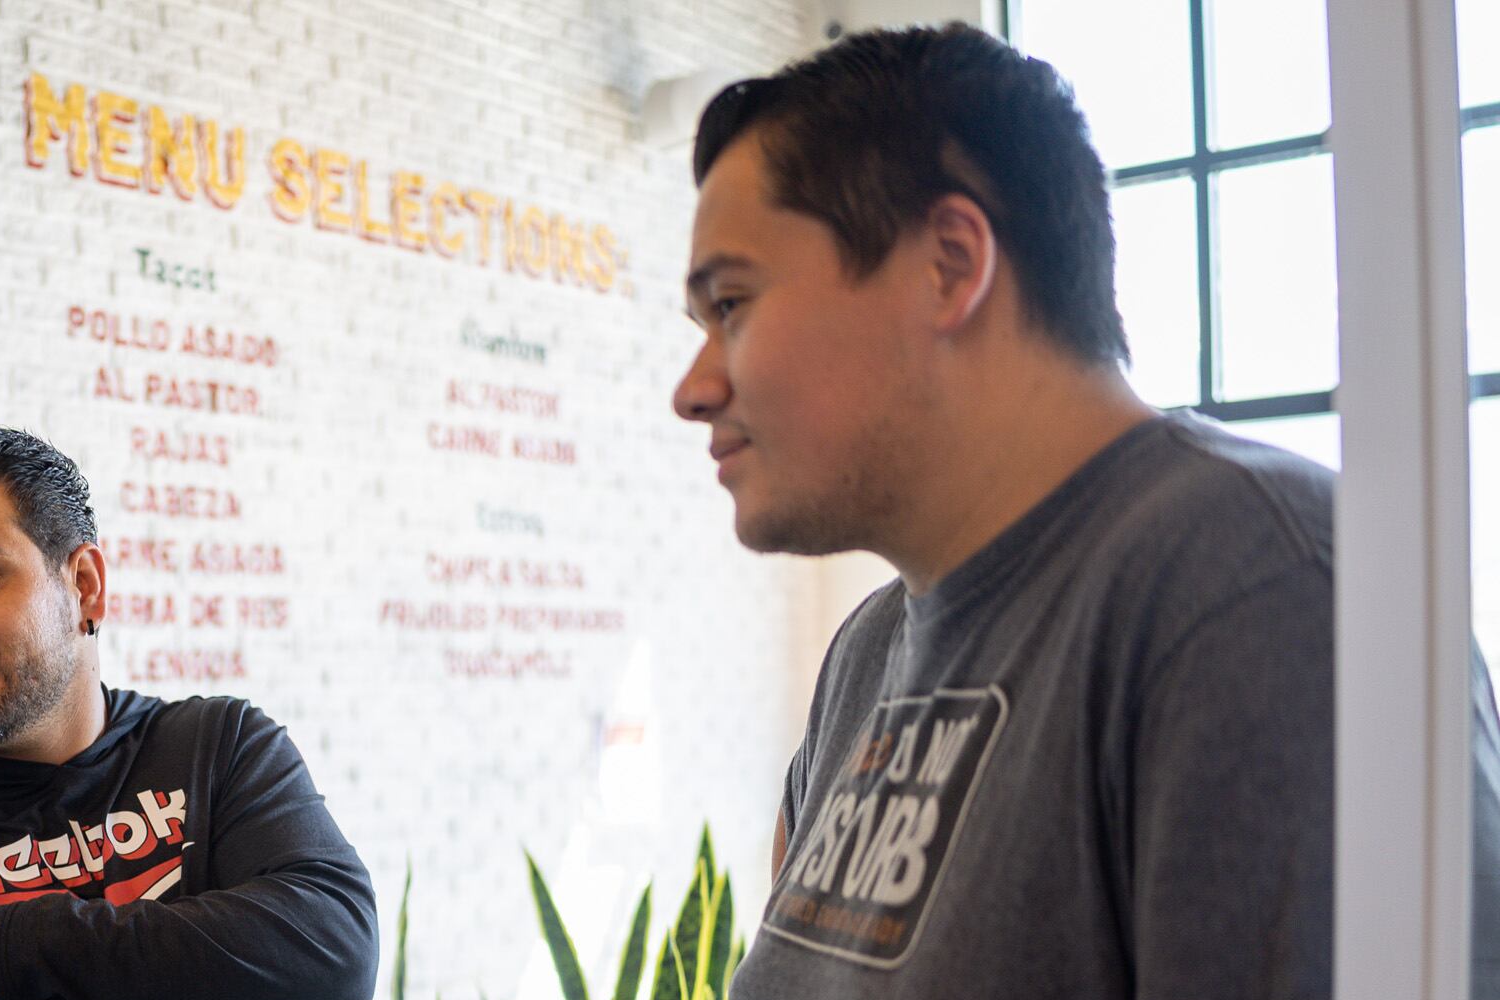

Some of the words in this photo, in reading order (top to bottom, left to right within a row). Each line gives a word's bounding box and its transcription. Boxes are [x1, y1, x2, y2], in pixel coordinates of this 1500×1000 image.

[23, 72, 245, 211] MENU
[67, 304, 171, 352] POLLO
[180, 323, 278, 368] ASADO
[94, 366, 135, 404] AL
[144, 373, 260, 417] PASTOR
[131, 425, 229, 467] RAJAS
[119, 480, 241, 521] CABEZA
[189, 595, 224, 628] DE
[237, 596, 288, 630] RES
